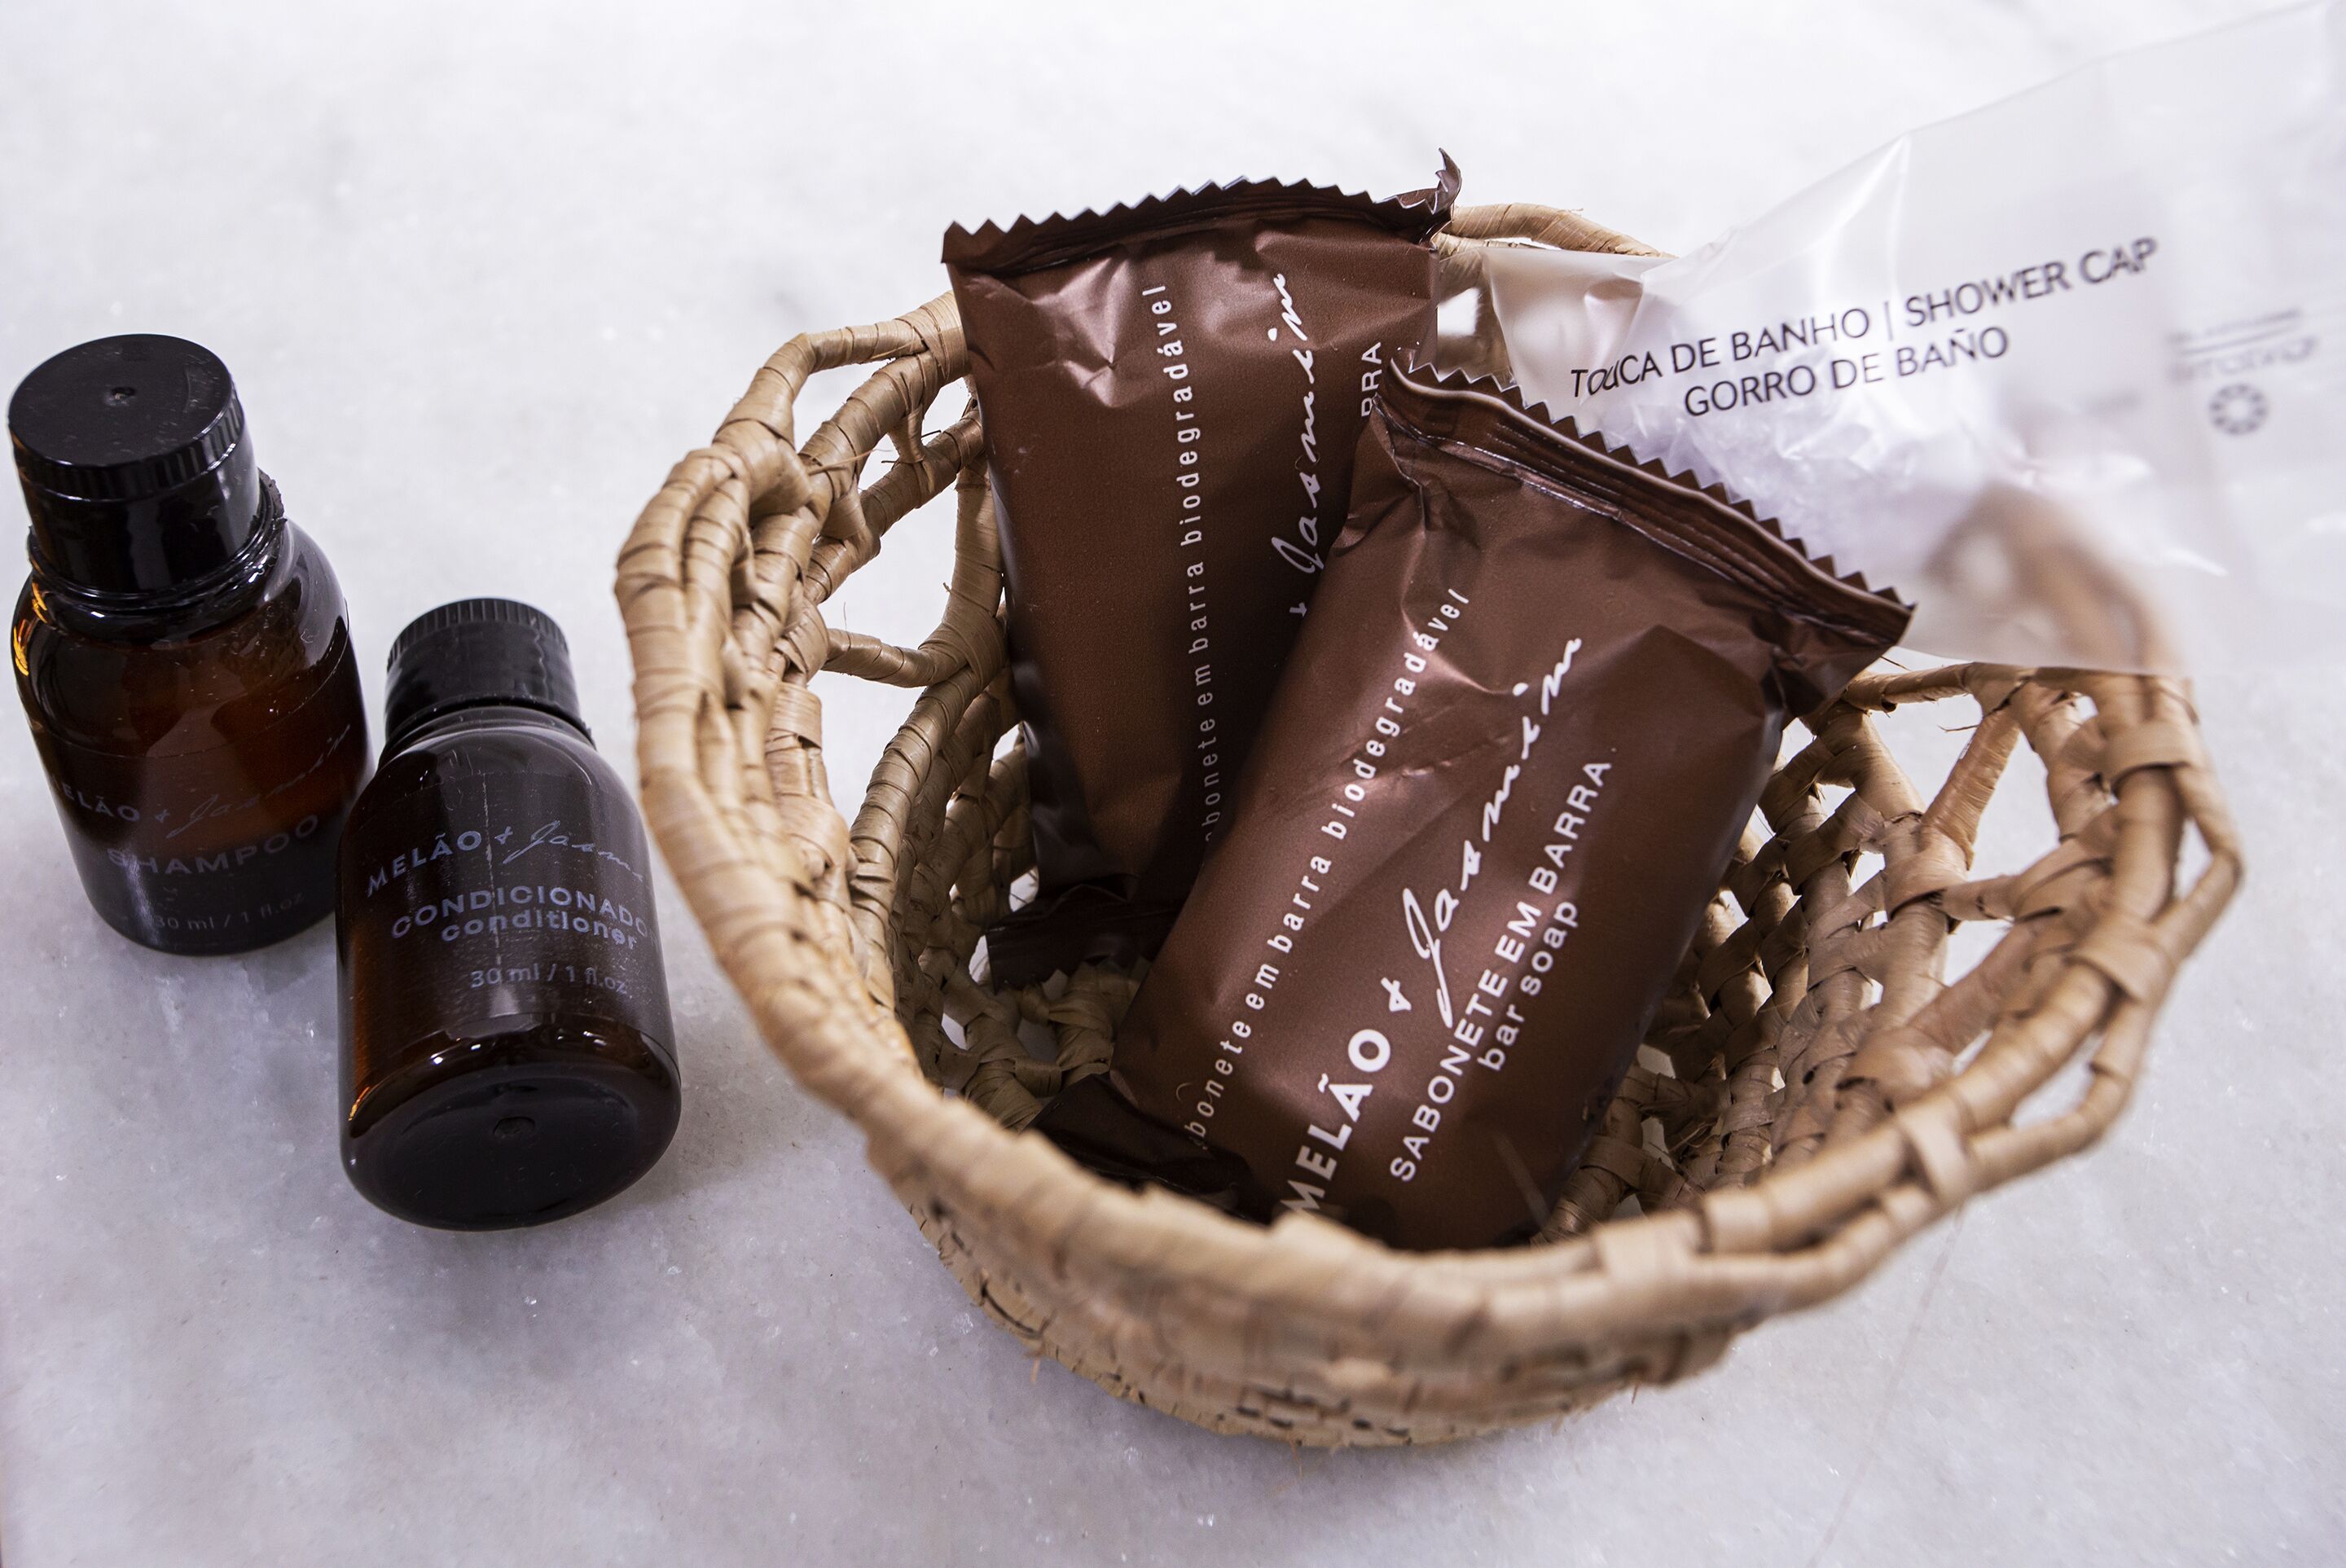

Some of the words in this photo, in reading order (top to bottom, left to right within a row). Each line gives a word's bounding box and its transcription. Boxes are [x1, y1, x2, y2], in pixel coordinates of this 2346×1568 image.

[1671, 337, 1720, 373] DE
[1731, 308, 1869, 361] BANHO
[1905, 260, 2072, 327] SHOWER
[2078, 237, 2159, 284] CAP
[1142, 286, 1202, 547] biodegradável
[1684, 365, 1817, 417] GORRO
[1831, 354, 1883, 389] DE
[1896, 326, 2008, 376] BAÑO
[1187, 561, 1209, 654] barra
[1193, 663, 1214, 706] em
[108, 815, 319, 875] SHAMPOO
[1245, 960, 1280, 1012] em
[1267, 855, 1332, 953] barra
[1320, 588, 1469, 840] biodegradável
[367, 831, 482, 897] MELÃO
[502, 820, 644, 883] Jasmi
[152, 914, 179, 930] 30
[187, 916, 215, 931] ml
[240, 911, 250, 924] 1
[441, 909, 637, 950] conditioner
[1280, 1029, 1390, 1211] MELÃO
[1402, 639, 1581, 1028] Jasmim
[469, 968, 502, 990] 30
[506, 963, 540, 982] ml
[547, 963, 557, 982] /
[565, 964, 575, 983] 1
[1390, 969, 1508, 1183] SABONETE
[1494, 900, 1542, 964] EM
[1528, 762, 1612, 894] BARRA
[1478, 1004, 1526, 1072] bar
[1520, 901, 1578, 997] soap
